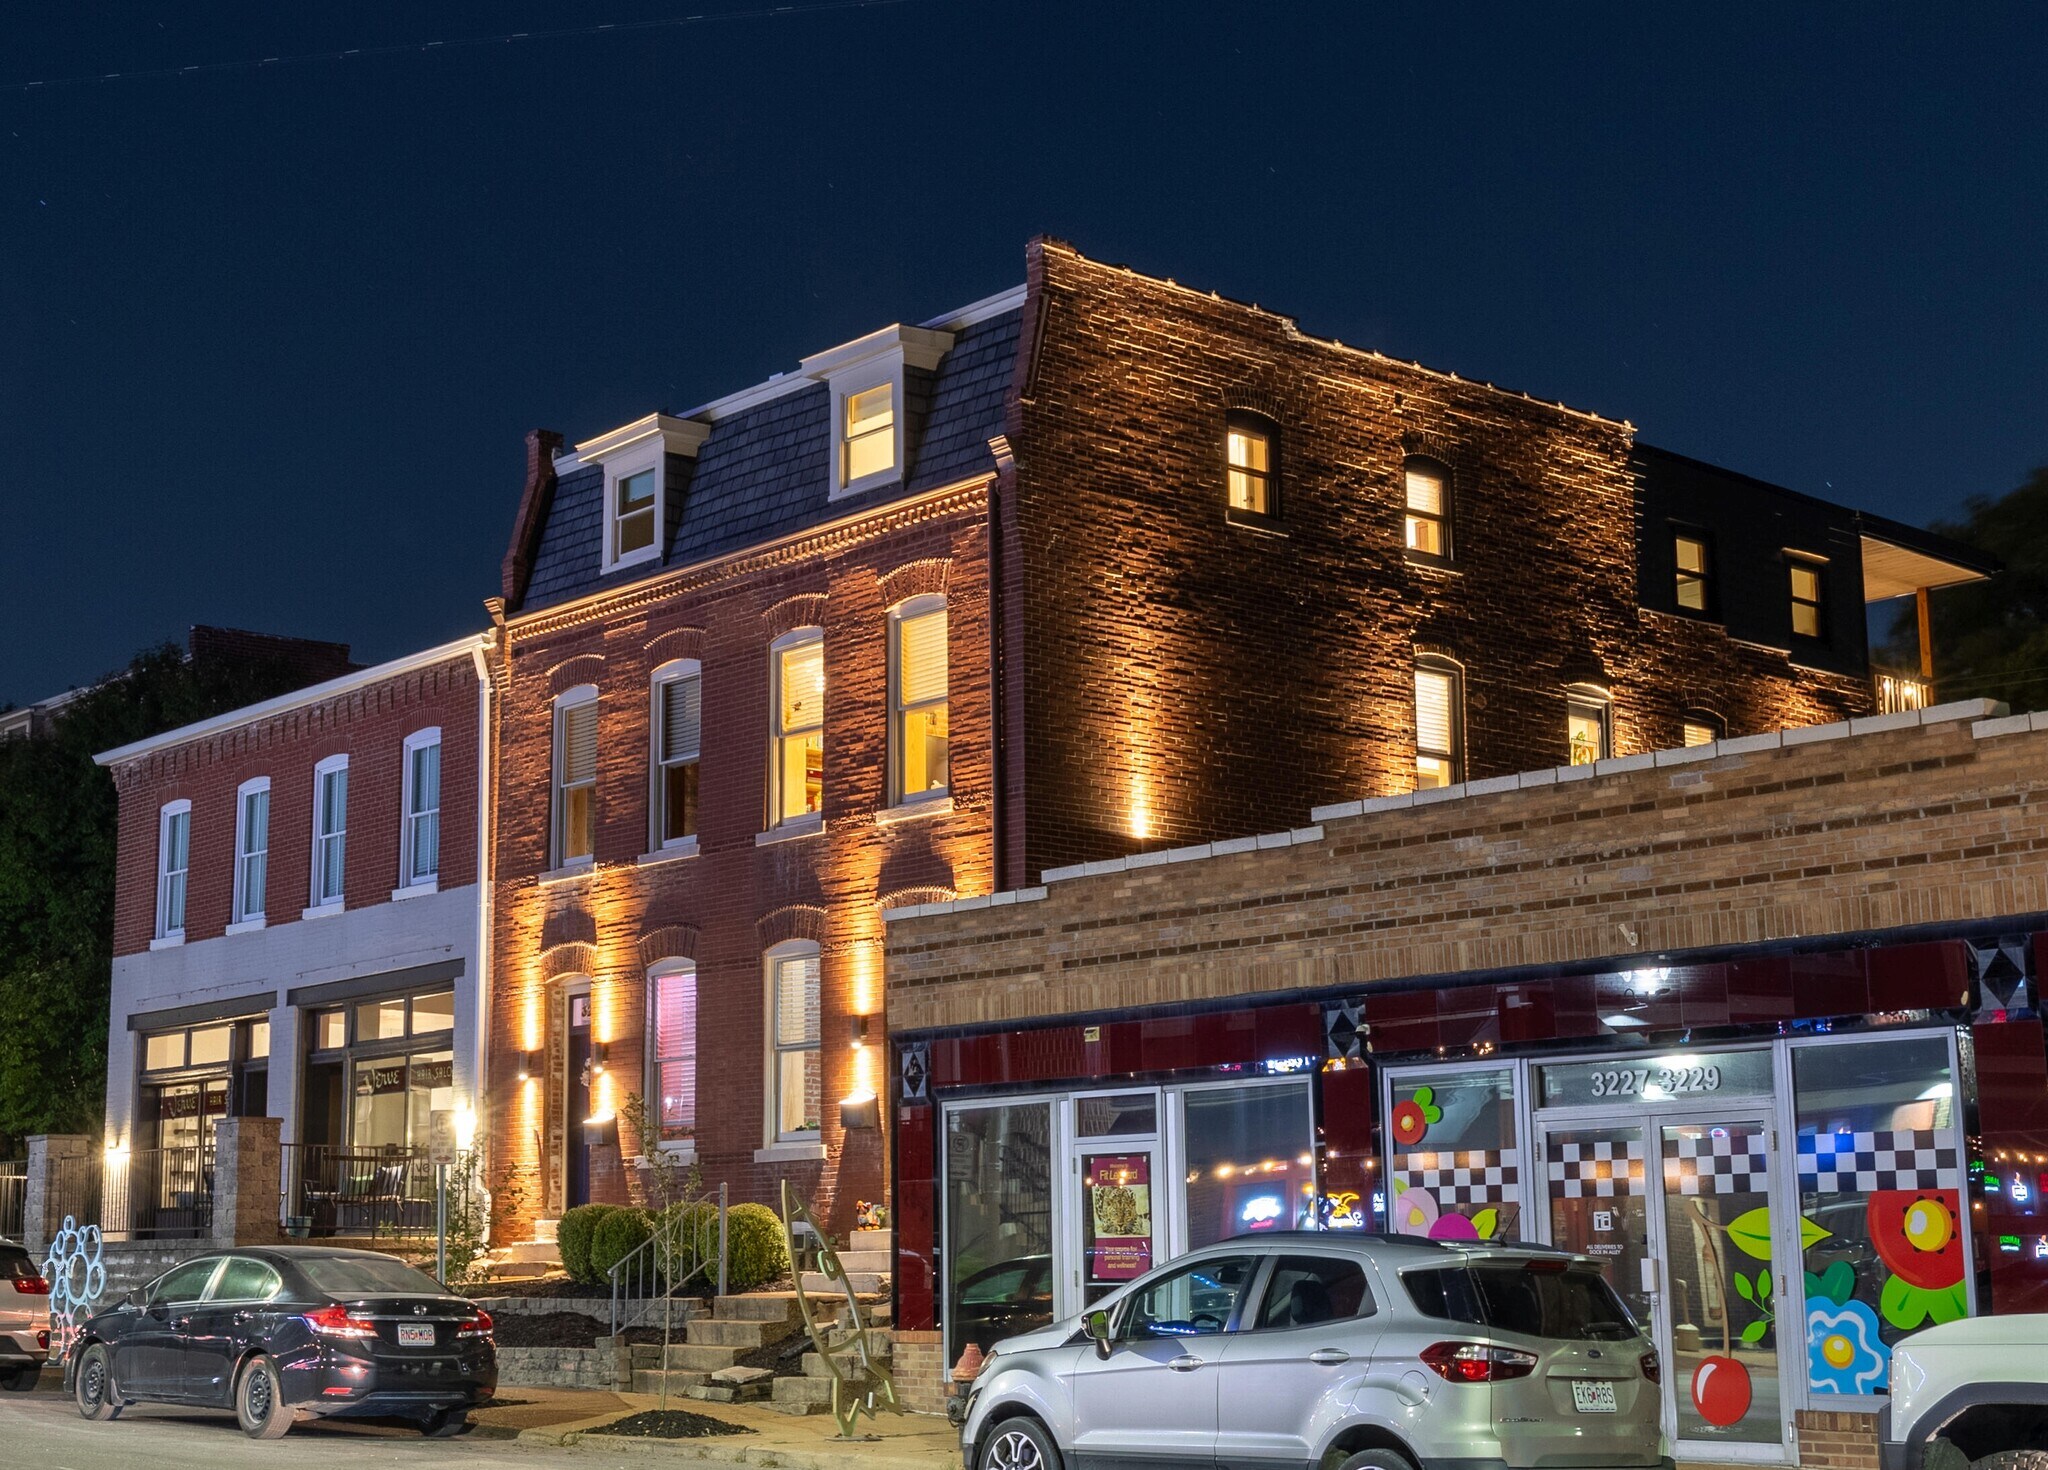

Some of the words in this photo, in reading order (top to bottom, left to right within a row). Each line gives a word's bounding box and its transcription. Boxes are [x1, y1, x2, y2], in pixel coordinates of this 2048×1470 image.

[432, 1065, 453, 1081] SALO
[1591, 1069, 1650, 1097] 3227
[1658, 1066, 1720, 1093] 3229
